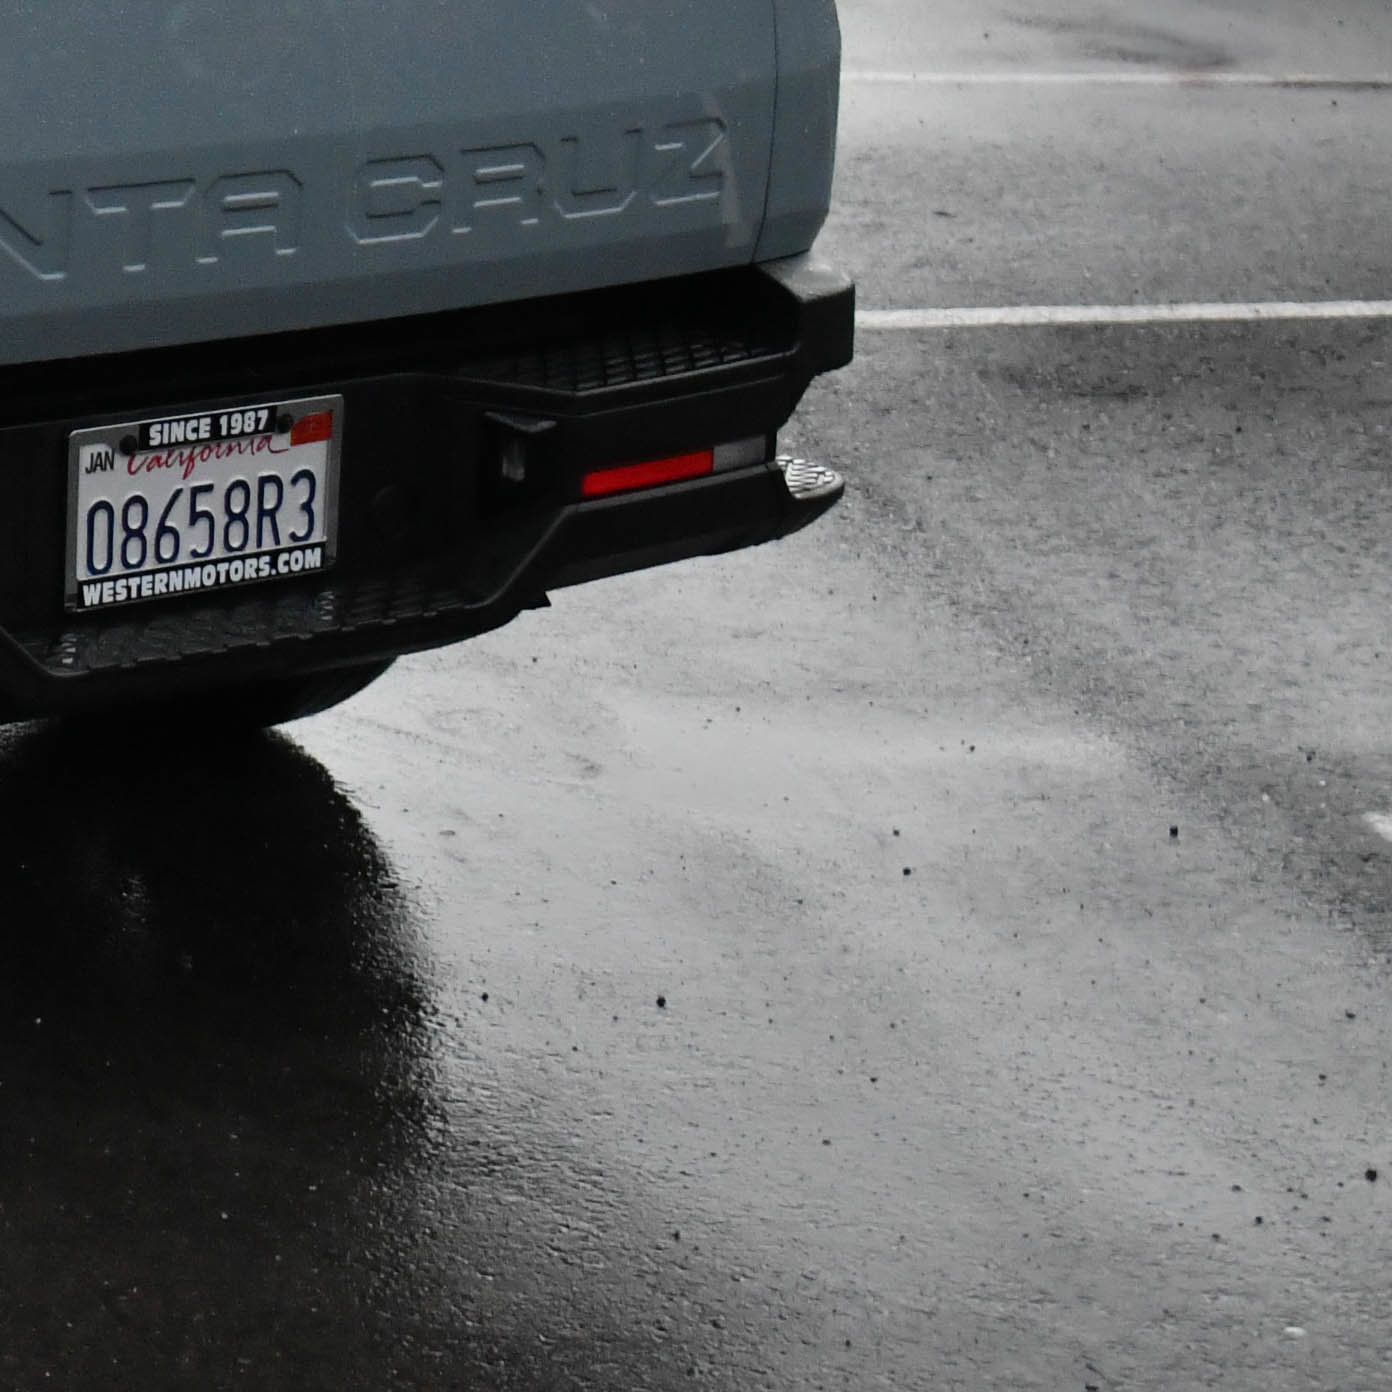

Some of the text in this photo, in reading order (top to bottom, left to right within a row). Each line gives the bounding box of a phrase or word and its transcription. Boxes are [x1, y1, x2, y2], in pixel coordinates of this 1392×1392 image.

[345, 118, 727, 245] CRUZ
[149, 409, 269, 446] SINCE 1987
[85, 450, 115, 474] JAN
[86, 468, 317, 575] 08658R3
[82, 547, 322, 606] WESTERNMOTORS.COM
